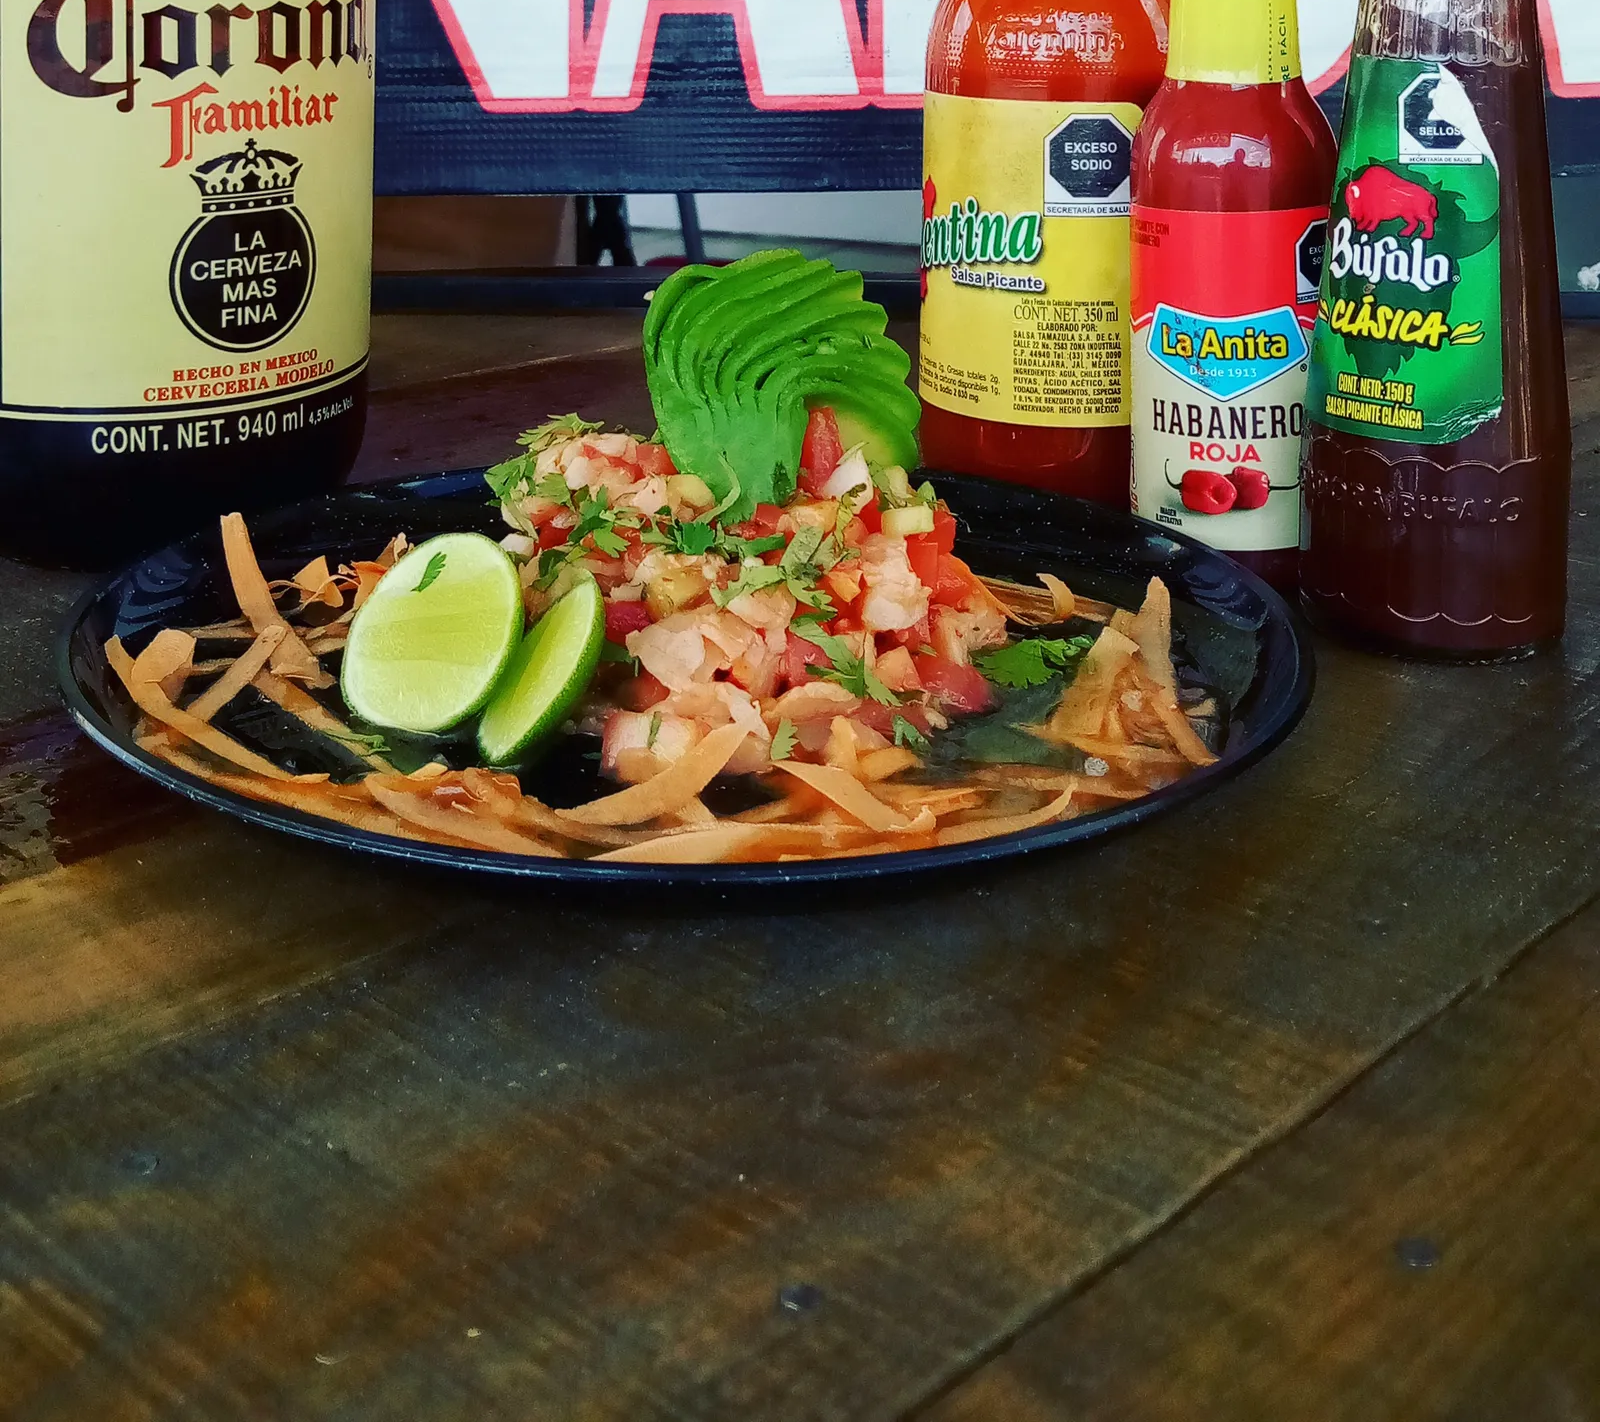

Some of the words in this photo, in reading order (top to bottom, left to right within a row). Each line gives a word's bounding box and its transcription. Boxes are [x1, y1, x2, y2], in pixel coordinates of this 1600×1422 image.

[1277, 14, 1287, 56] FÁCIL
[151, 81, 339, 168] Familiar
[1418, 126, 1461, 136] SELLOS
[1064, 142, 1118, 154] EXCESO
[1070, 159, 1112, 171] SODIO
[1046, 205, 1096, 214] SECRETARÍA
[1097, 206, 1108, 214] DE
[1108, 206, 1132, 214] SALU
[234, 230, 267, 253] LA
[921, 197, 1041, 267] entina
[190, 249, 302, 281] CERVEZA
[1329, 216, 1449, 293] Búfalo
[951, 265, 982, 284] Salsa
[986, 271, 1043, 290] Picante
[222, 277, 278, 303] MAS
[221, 302, 278, 329] FINA
[1013, 304, 1051, 322] CONT.
[1053, 306, 1081, 323] NET.
[1084, 307, 1103, 323] 350
[1105, 306, 1119, 322] ml
[1331, 294, 1449, 347] CLÁSICA
[1013, 330, 1035, 340] SALSA
[1038, 331, 1076, 341] TAMAZULA
[1096, 333, 1105, 341] DE
[1108, 333, 1122, 341] C.V.
[1037, 322, 1080, 332] ELABORADO
[1081, 323, 1098, 332] POR:
[1013, 339, 1031, 348] CALLE
[1032, 340, 1040, 349] 22
[1069, 342, 1086, 350] ZONA
[1087, 342, 1122, 350] INDUSTRIAL
[1161, 323, 1193, 357] La
[1198, 327, 1289, 360] Anita
[172, 364, 234, 382] HECHO
[239, 360, 262, 375] EN
[265, 348, 318, 370] MEXICO
[1013, 367, 1058, 378] INGREDIENTES:
[1080, 370, 1101, 378] CHILES
[1103, 369, 1122, 377] SECOS
[1189, 364, 1225, 377] Desde
[1227, 367, 1257, 378] 1913
[143, 376, 270, 403] CERVECERIA
[275, 358, 334, 387] MODELO
[1042, 387, 1091, 397] CONDIMENTOS,
[1092, 387, 1122, 397] ESPECIAS
[1043, 377, 1068, 386] ÁCIDO
[1338, 373, 1359, 395] CONT.
[1360, 377, 1384, 399] NETO:
[1384, 381, 1405, 402] 150
[1405, 384, 1414, 405] g
[1034, 396, 1043, 404] DE
[1044, 397, 1075, 405] BENZOATO
[1075, 397, 1084, 405] DE
[1085, 397, 1104, 406] SODIO
[1104, 397, 1122, 405] COMO
[1058, 405, 1082, 414] HECHO
[1083, 405, 1093, 414] EN
[1325, 394, 1346, 415] SALSA
[1346, 399, 1381, 424] PICANTE
[1381, 403, 1423, 430] CLÁSICA
[91, 424, 169, 455] CONT.
[177, 419, 230, 450] NET.
[238, 409, 276, 442] 940
[282, 403, 304, 433] ml
[1152, 397, 1305, 440] HABANERO
[1189, 440, 1262, 463] ROJA
